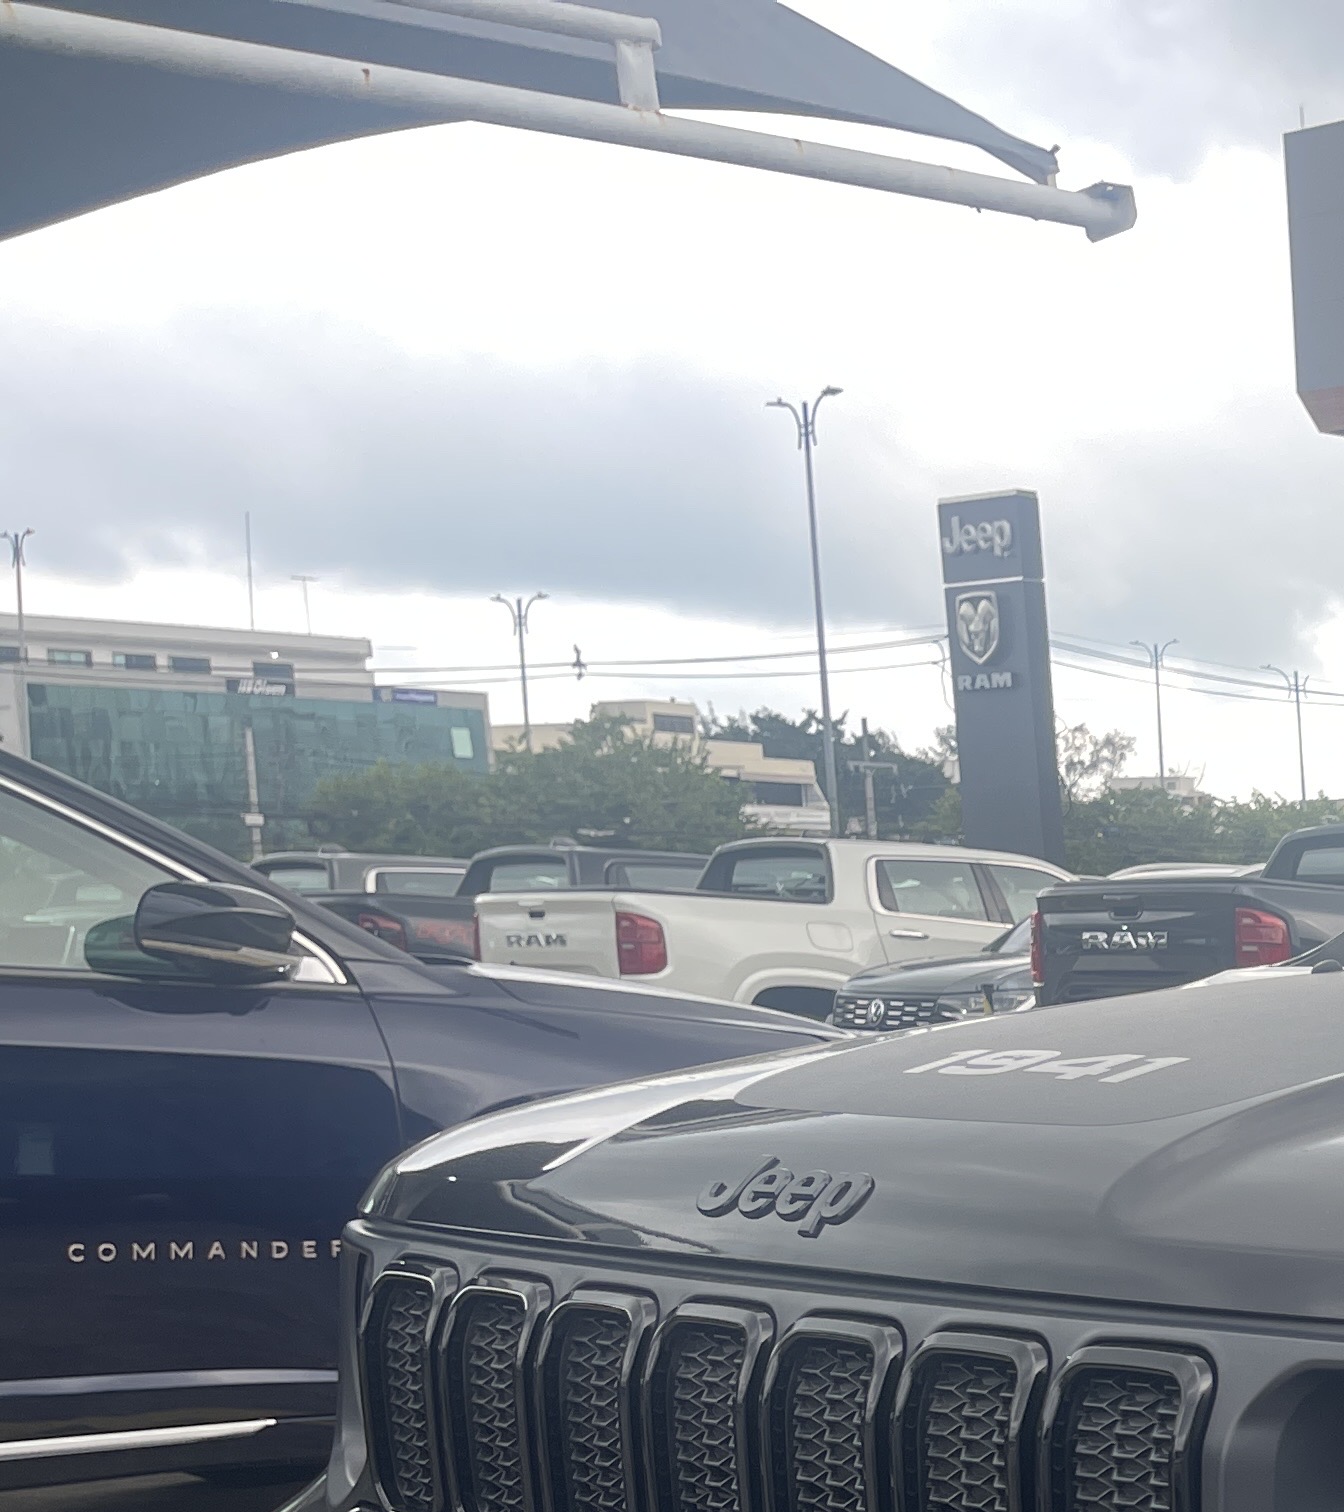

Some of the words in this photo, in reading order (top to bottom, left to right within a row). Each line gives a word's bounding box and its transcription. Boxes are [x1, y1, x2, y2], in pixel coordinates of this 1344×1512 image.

[942, 516, 1012, 557] Jeep
[957, 671, 1012, 691] RAM
[506, 932, 567, 948] RAM
[1081, 931, 1168, 950] RAM
[903, 1049, 1191, 1083] 1941
[696, 1153, 875, 1239] Jeep
